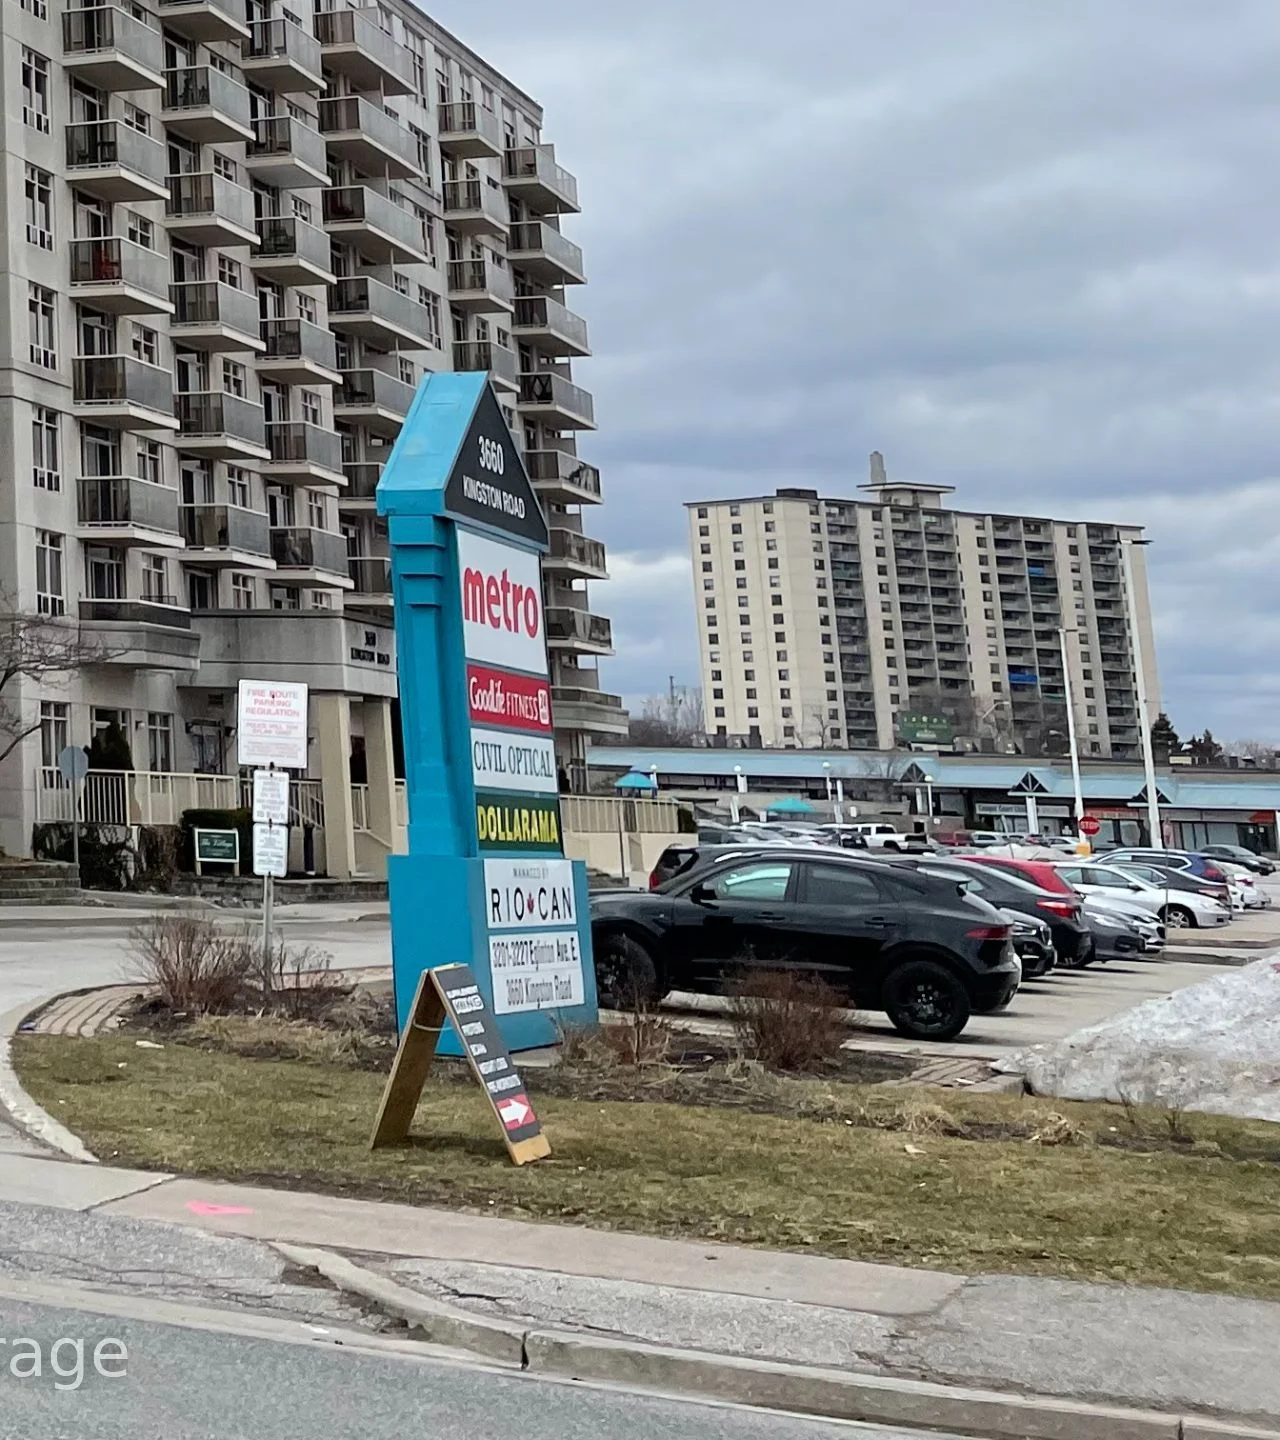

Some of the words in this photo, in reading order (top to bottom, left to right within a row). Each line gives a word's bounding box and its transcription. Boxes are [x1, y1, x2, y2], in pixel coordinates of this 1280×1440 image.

[478, 435, 504, 476] 3660
[463, 475, 502, 511] KINGSTON
[503, 491, 526, 519] ROAD
[464, 567, 538, 639] metro
[245, 707, 300, 717] REGULATION
[247, 688, 265, 697] FIRE
[269, 689, 298, 699] ROUTE
[253, 698, 291, 708] PARKING
[470, 676, 505, 714] GoodLife
[506, 692, 539, 721] FITNESS
[473, 741, 506, 773] CIVIL
[507, 746, 554, 778] OPTICAL
[477, 805, 559, 843] DOLLARAMA
[525, 977, 554, 1009] Kingston
[554, 975, 572, 1000] Road
